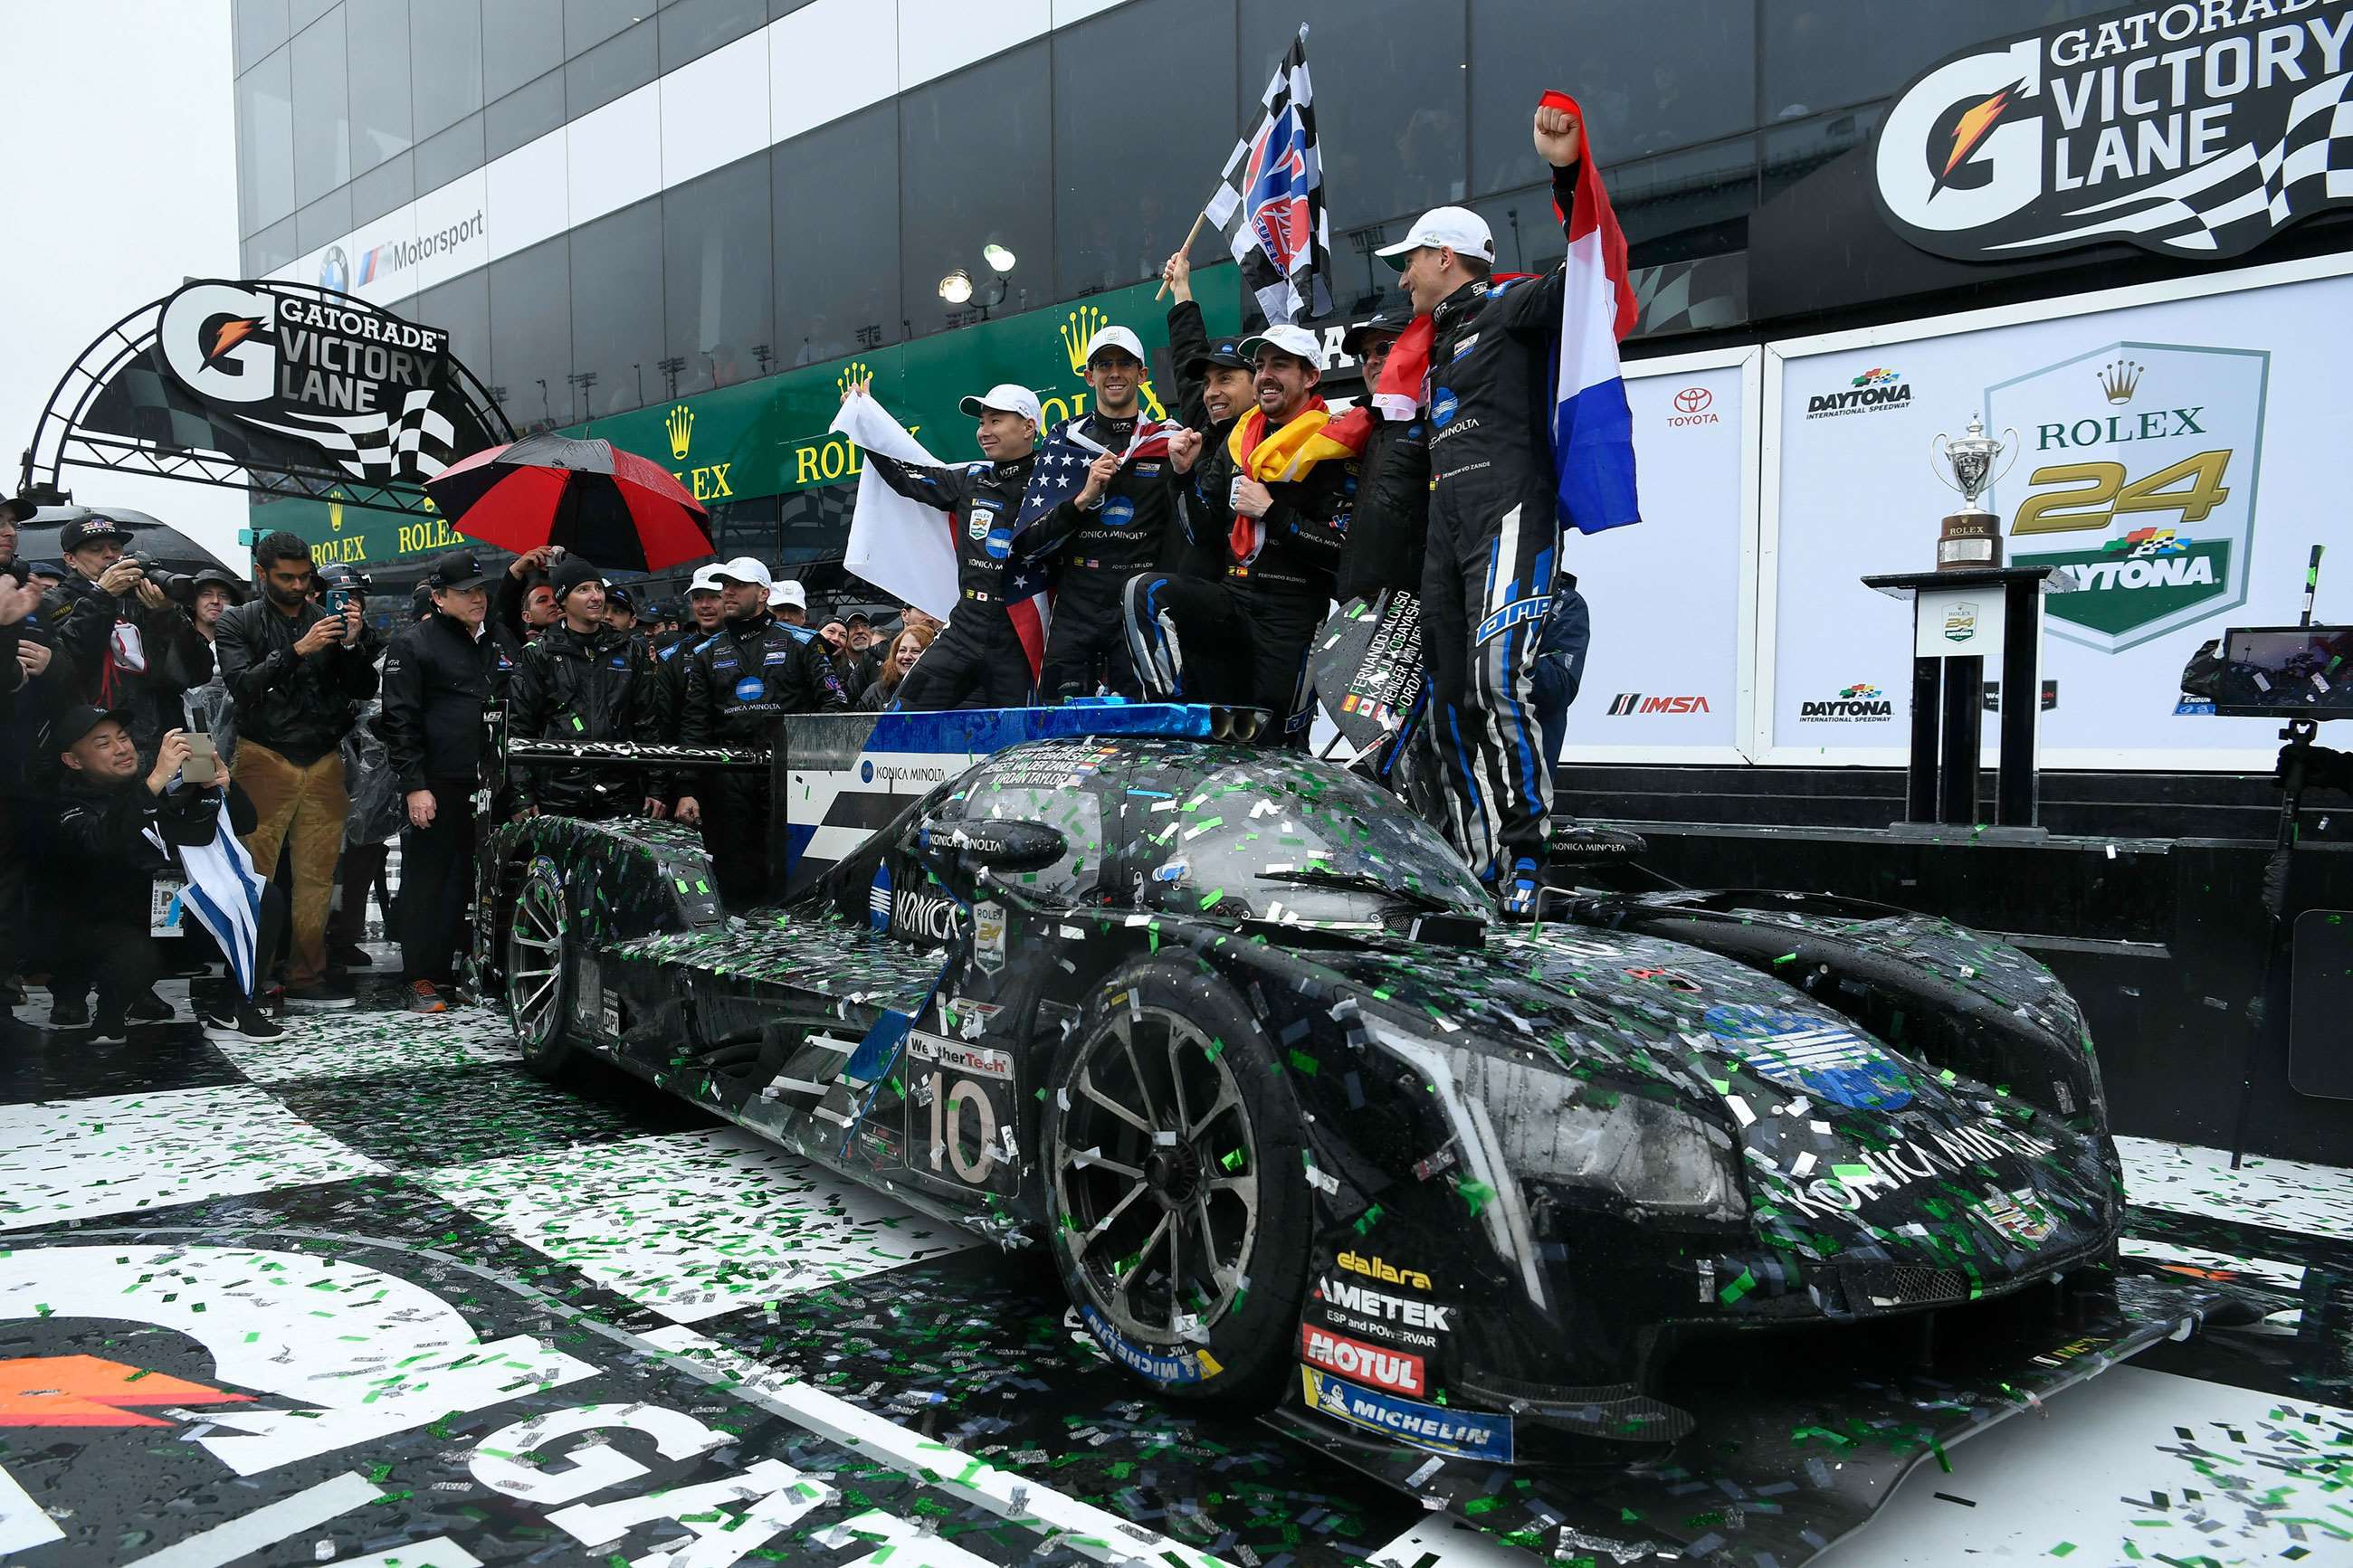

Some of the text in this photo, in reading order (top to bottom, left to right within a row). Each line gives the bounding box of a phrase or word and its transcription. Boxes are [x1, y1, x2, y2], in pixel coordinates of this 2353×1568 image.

[2051, 10, 2353, 130] VICTORY
[2056, 102, 2234, 192] LANE
[394, 209, 482, 271] Motorsport
[280, 299, 437, 354] GATORADE
[280, 326, 434, 387] VICTORY
[281, 365, 377, 413] LANE
[1808, 384, 1911, 413] DAYTONA
[1666, 413, 1720, 428] TOYOTA
[1806, 402, 1911, 421] INTERNATIONAL SPEEDWAY
[2036, 406, 2206, 451] ROLEX
[999, 465, 1020, 478] WTR
[1470, 461, 1491, 470] ZANDE
[2009, 448, 2234, 537] 24
[1949, 526, 1985, 536] ROLEX
[1349, 590, 1411, 694] FERNANDO ALONSO
[1945, 617, 1975, 629] 24
[1381, 664, 1410, 706] RENGER
[1639, 696, 1710, 714] IMSA
[748, 703, 781, 711] MINOLTA
[1800, 700, 1892, 716] DAYTONA
[876, 766, 947, 782] KONICA MINOLTA
[1028, 773, 1069, 785] TAYLOR
[1553, 842, 1584, 851] KONICA
[894, 889, 962, 941] KONICA
[977, 923, 1002, 942] 24
[928, 1071, 996, 1184] 10
[1337, 1250, 1433, 1291] dallara
[1089, 1314, 1180, 1379] MICHELIN
[1327, 1309, 1437, 1348] ESP and POWERVAR
[1307, 1332, 1418, 1390] MOTUL
[1352, 1398, 1491, 1446] MICHELIN
